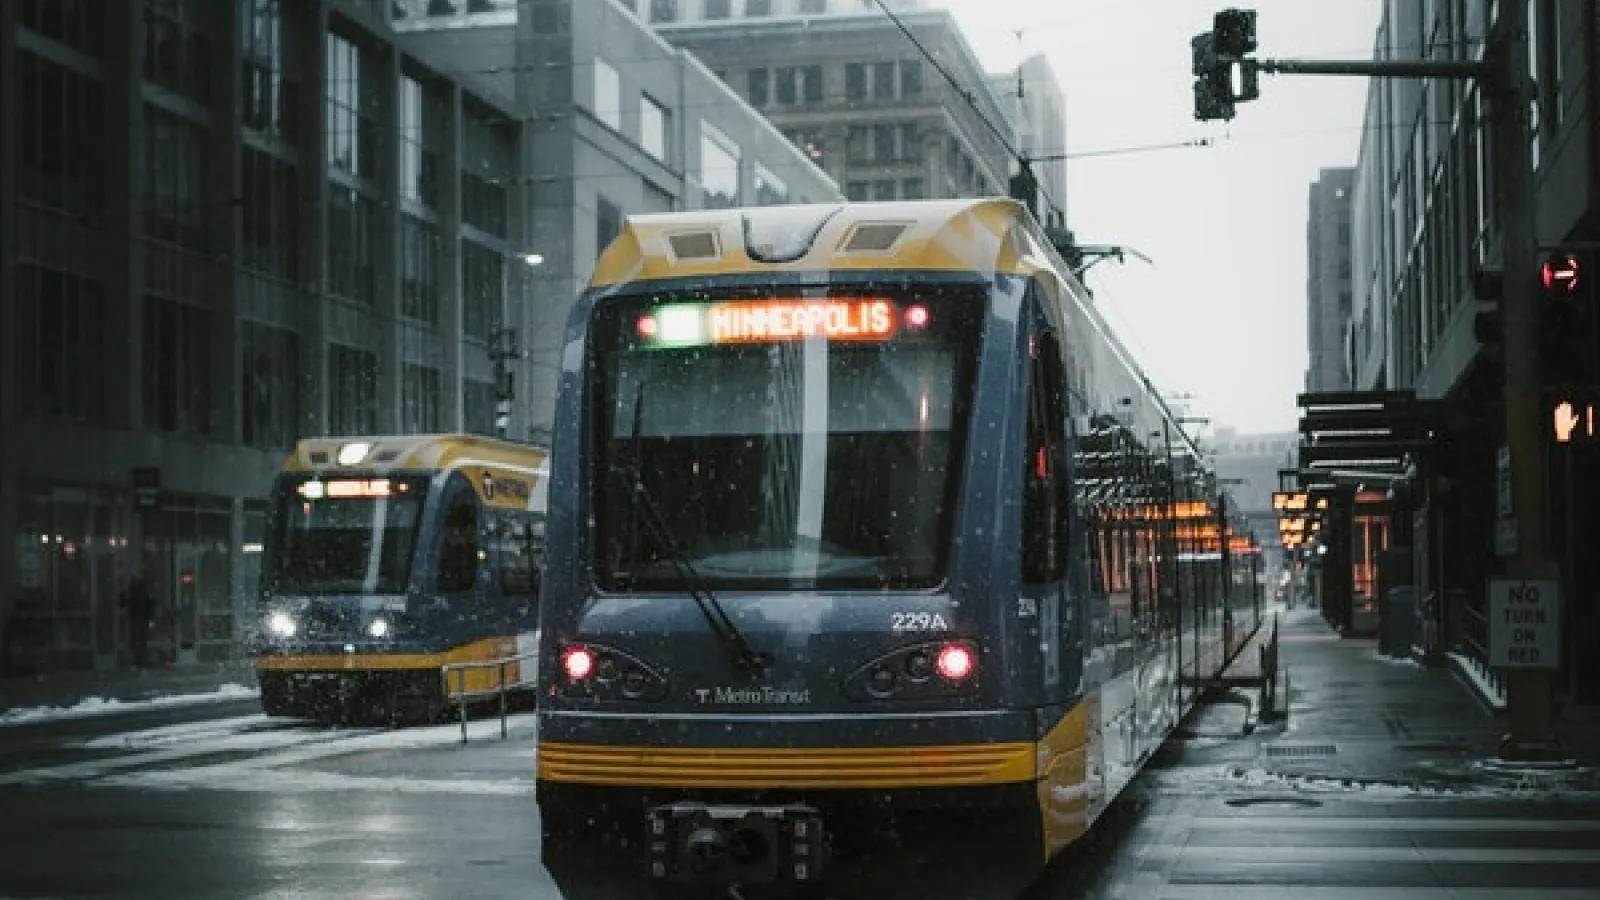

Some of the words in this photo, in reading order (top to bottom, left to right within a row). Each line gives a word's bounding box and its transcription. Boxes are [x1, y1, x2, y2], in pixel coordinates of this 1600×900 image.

[711, 302, 891, 337] MINNEAPOLIS
[1508, 586, 1539, 604] NO
[892, 612, 947, 631] 229A
[1504, 609, 1547, 623] TURN
[1514, 628, 1536, 643] ON
[1508, 647, 1540, 662] RED
